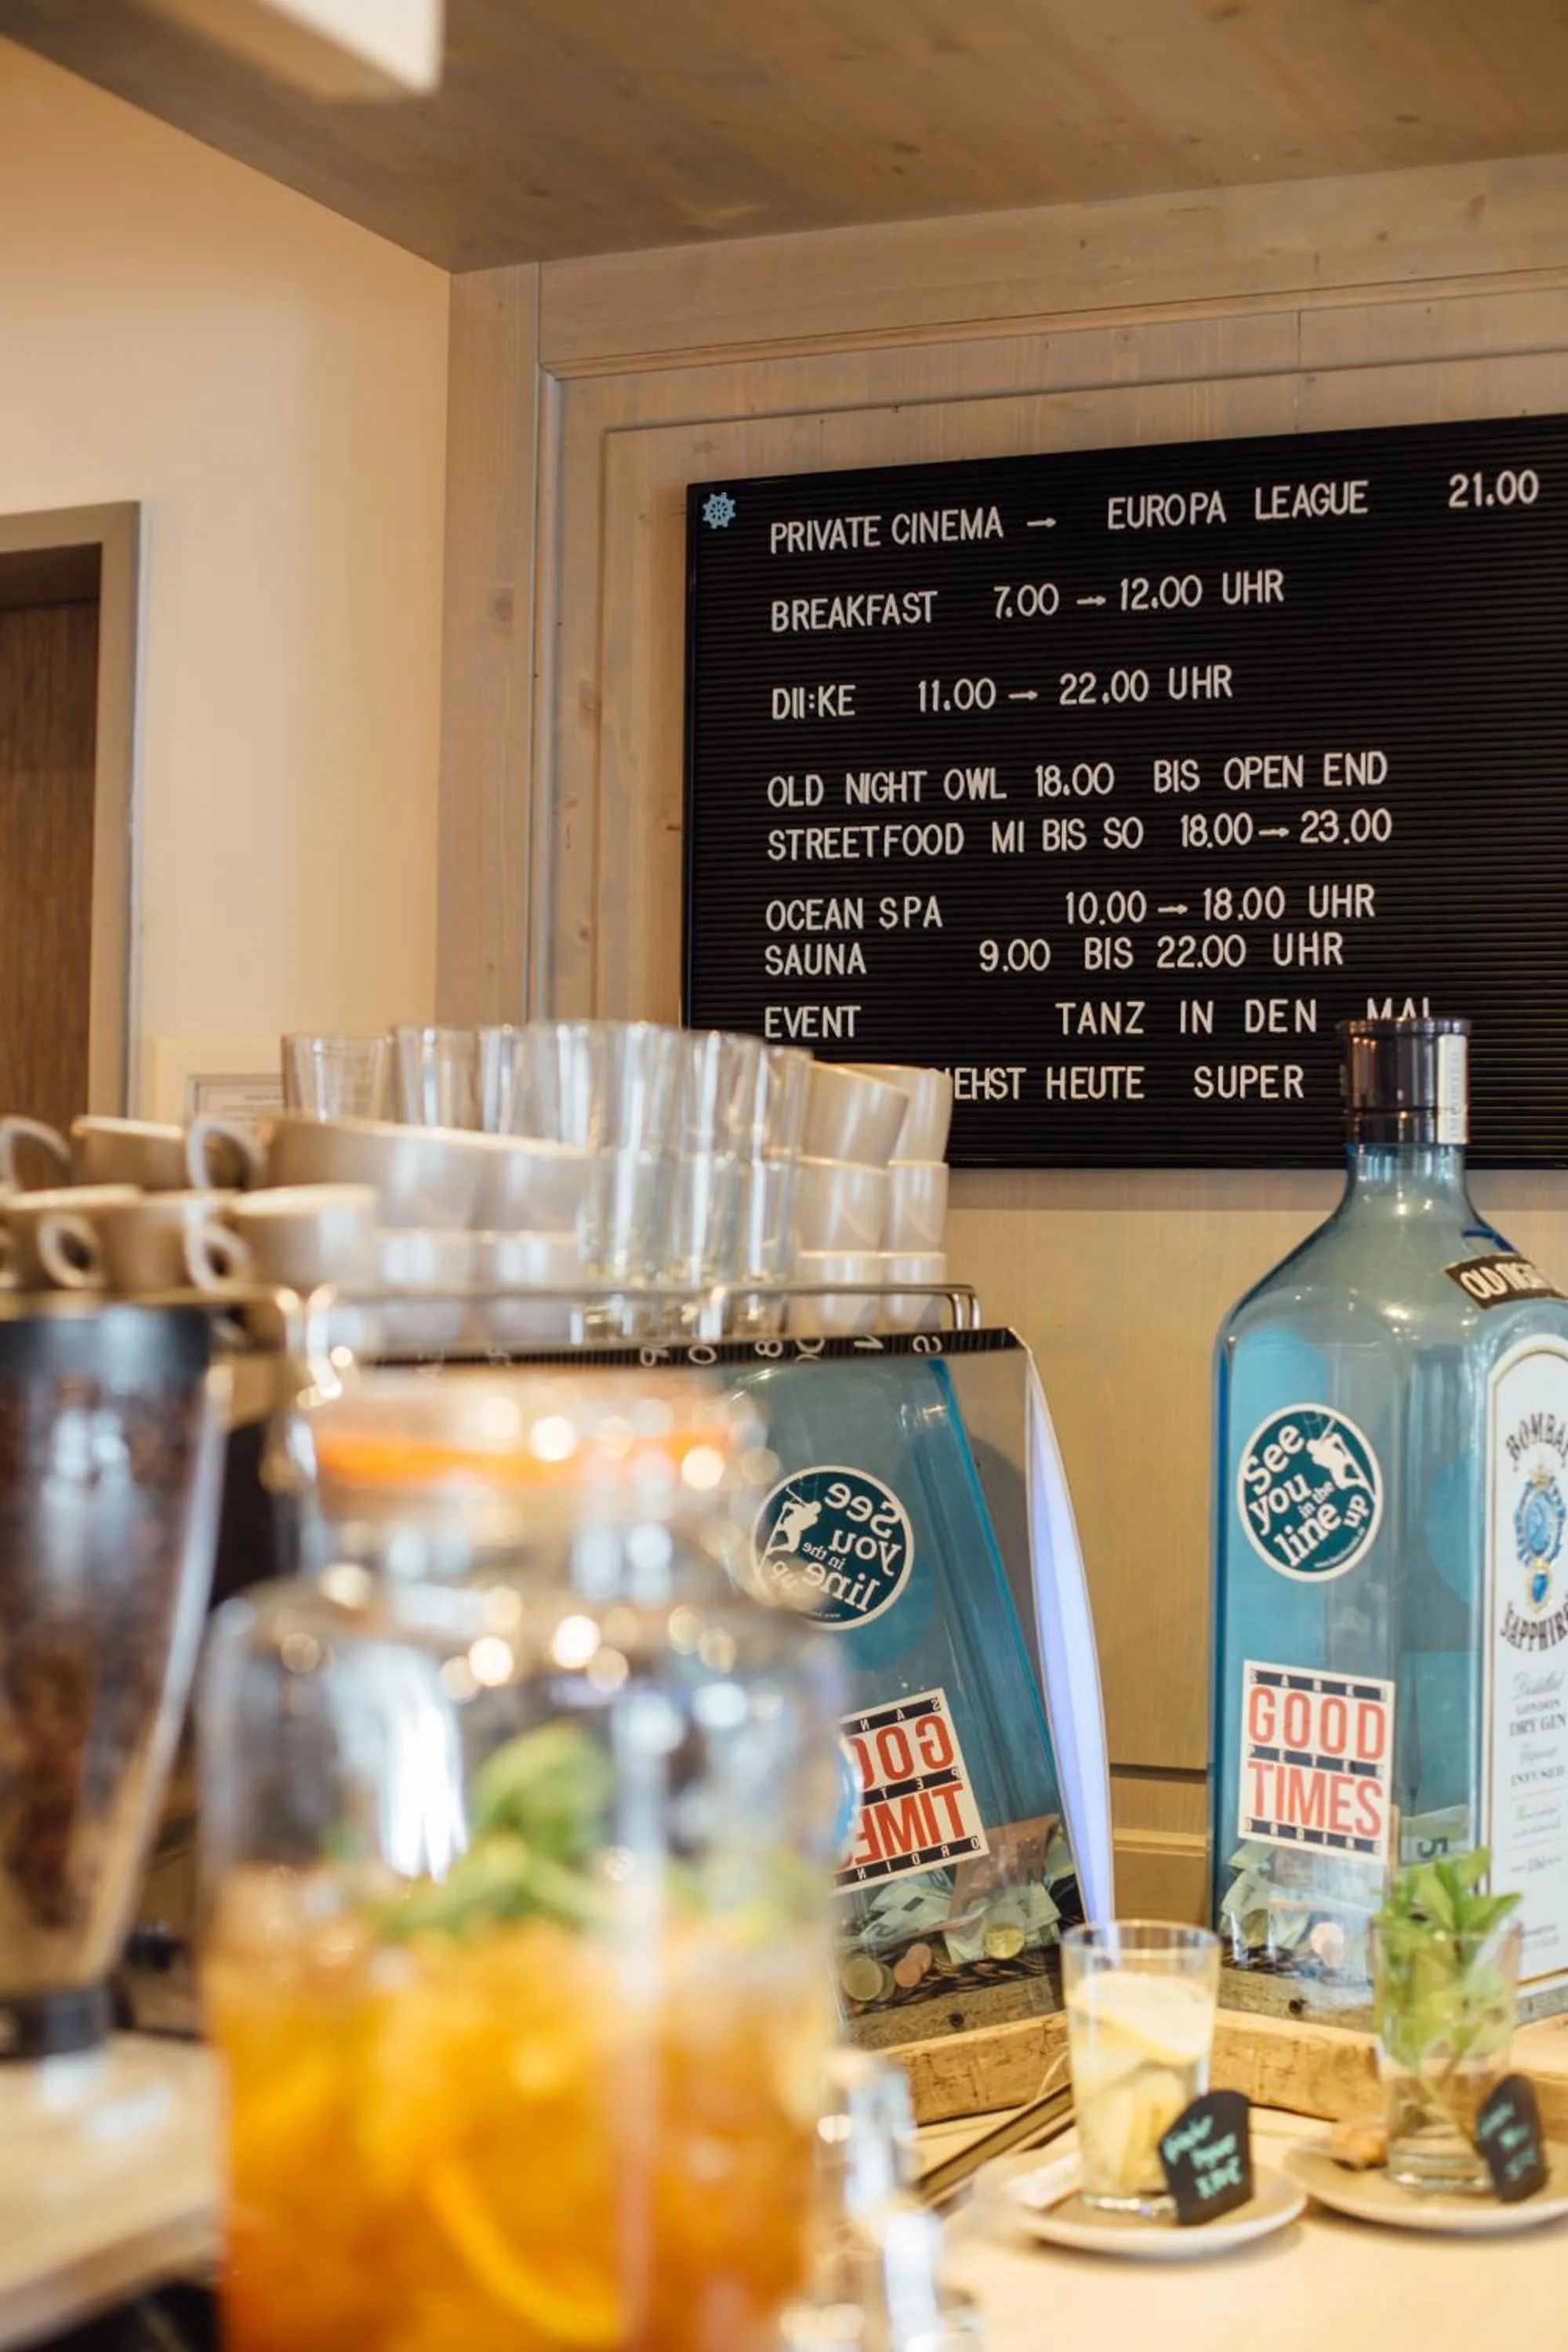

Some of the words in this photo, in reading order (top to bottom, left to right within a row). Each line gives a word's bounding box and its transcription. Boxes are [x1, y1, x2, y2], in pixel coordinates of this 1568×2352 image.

[771, 516, 880, 554] PRIVATE
[892, 506, 1004, 544] CINEMA
[1109, 491, 1226, 529] EUROPA
[1256, 481, 1368, 520] LEAGUE
[1449, 470, 1539, 507] 21.00
[772, 591, 938, 632] BREAKFAST
[994, 583, 1058, 619] 7.00
[1121, 575, 1203, 610] 12.00
[1223, 569, 1283, 604] UHR
[919, 677, 996, 712] 11.00
[1060, 670, 1149, 705] 22.00
[1169, 665, 1232, 699] UHR
[768, 775, 823, 808] OLD
[846, 771, 927, 804] NIGHT
[944, 768, 1007, 800] OWL
[1036, 763, 1114, 797] 18.00
[1154, 760, 1200, 793] BIS
[1224, 755, 1303, 790] OPEN
[1324, 751, 1388, 786] END
[768, 823, 964, 860] STREETFOOD
[993, 821, 1024, 853] MI
[1043, 818, 1087, 851] BIS
[1104, 817, 1143, 849] SO
[1181, 812, 1253, 848] 18.00
[1301, 808, 1392, 844] 23.00
[766, 898, 863, 931] OCEAN
[880, 896, 942, 929] SPA
[1066, 891, 1146, 925] 10.00
[1203, 886, 1285, 920] 18.00
[1309, 884, 1375, 918] UHR
[765, 942, 866, 975] SAUNA
[980, 939, 1051, 971] 9.00
[1085, 937, 1133, 970] BIS
[1157, 935, 1246, 967] 22.00
[1273, 931, 1343, 966] UHR
[764, 1005, 862, 1038] EVENT
[1055, 1001, 1145, 1035] TANZ
[1181, 1000, 1213, 1033] IN
[1245, 999, 1316, 1033] DEN
[945, 1068, 1027, 1100] EHST
[1047, 1066, 1145, 1100] HEUTE
[1194, 1065, 1304, 1098] SUPER
[1506, 1412, 1568, 1463] BOMBA
[1249, 1474, 1312, 1536] you
[1274, 1504, 1342, 1566] line
[1343, 1494, 1370, 1528] up
[1500, 1592, 1568, 1653] SAPPHIR
[1248, 1686, 1385, 1761] GOOD
[1247, 1760, 1384, 1838] TIMES
